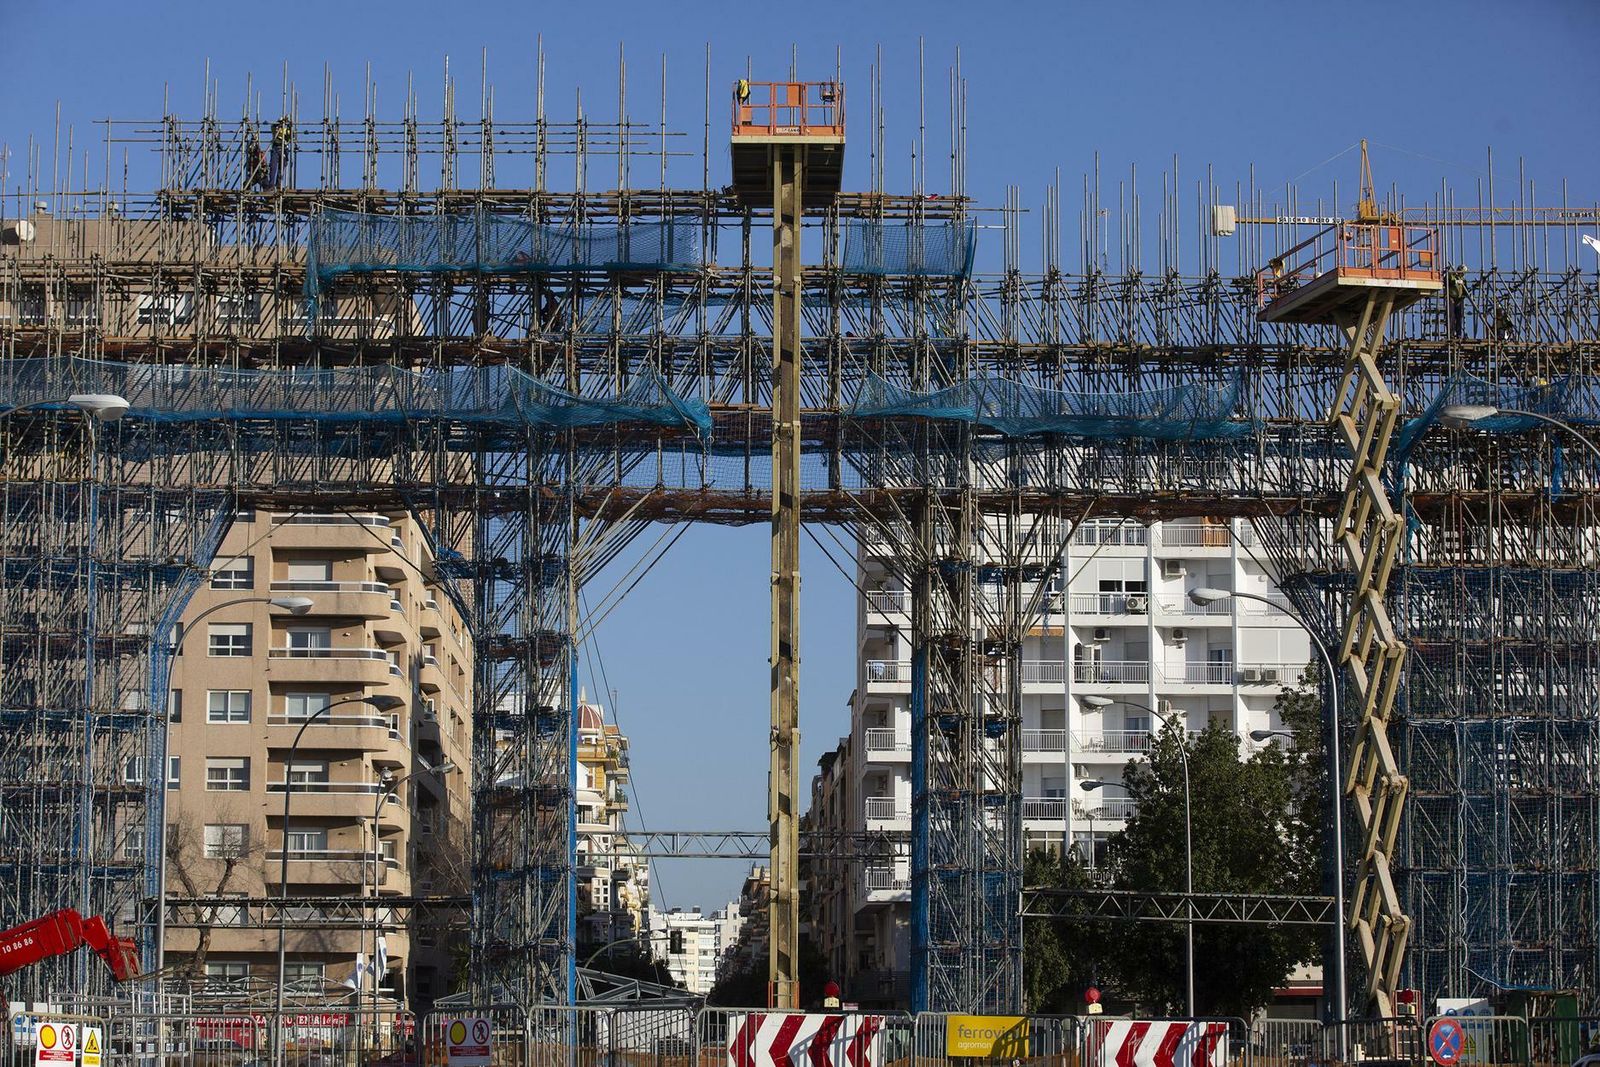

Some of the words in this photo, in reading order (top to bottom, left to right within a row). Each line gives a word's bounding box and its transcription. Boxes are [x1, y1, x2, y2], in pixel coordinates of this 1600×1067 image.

[2, 945, 11, 954] 10
[12, 941, 23, 950] 86
[23, 937, 33, 946] 86
